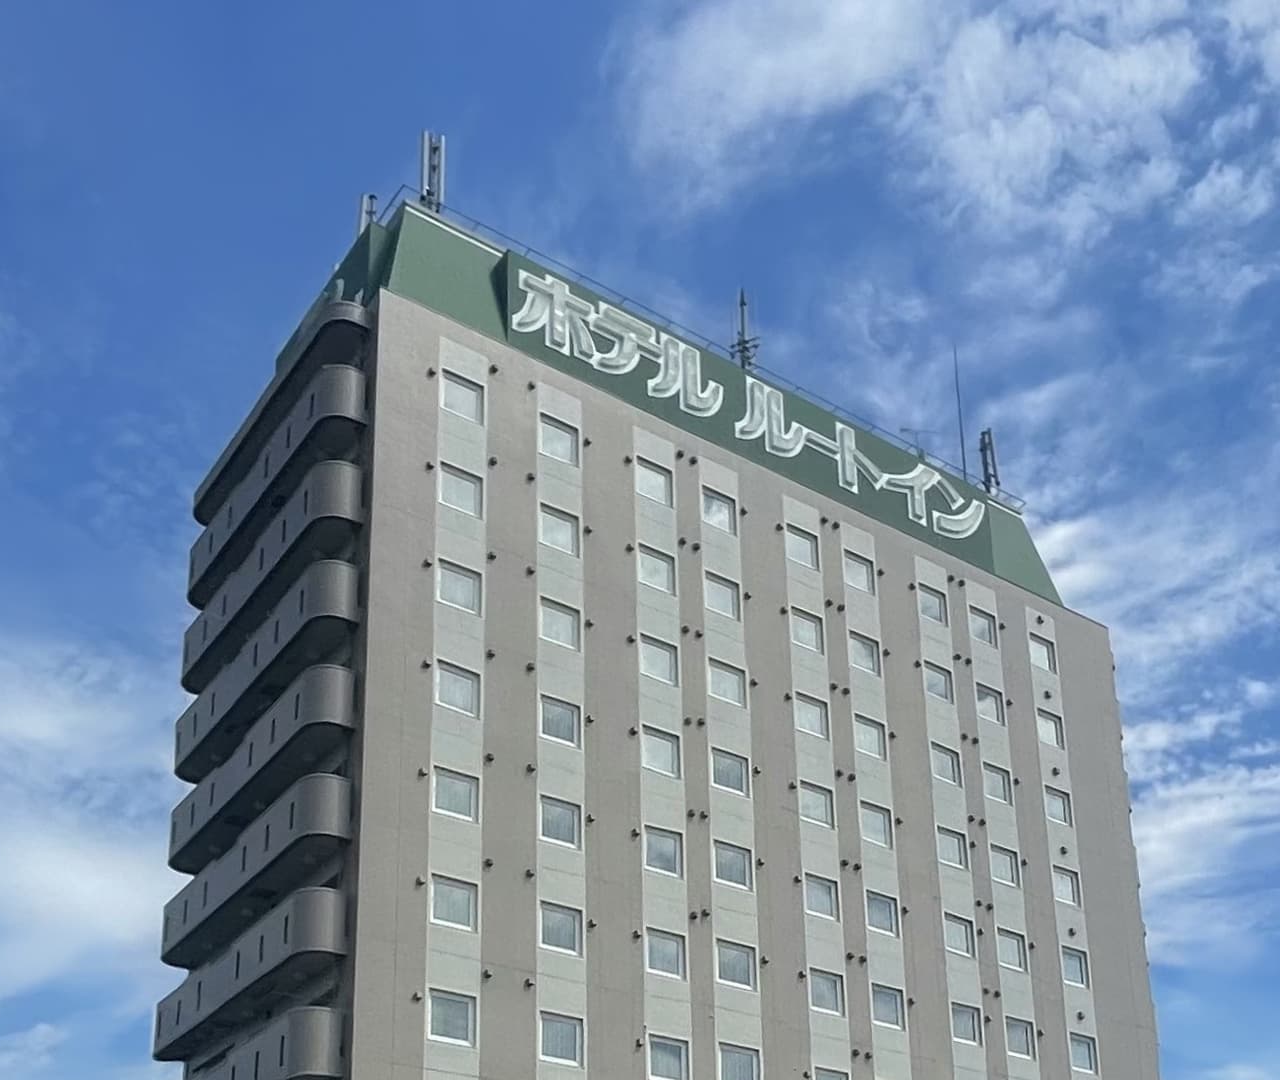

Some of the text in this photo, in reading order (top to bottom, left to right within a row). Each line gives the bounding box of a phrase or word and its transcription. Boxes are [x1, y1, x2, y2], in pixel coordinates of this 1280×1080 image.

[511, 268, 986, 540] ホテル ルートイン
